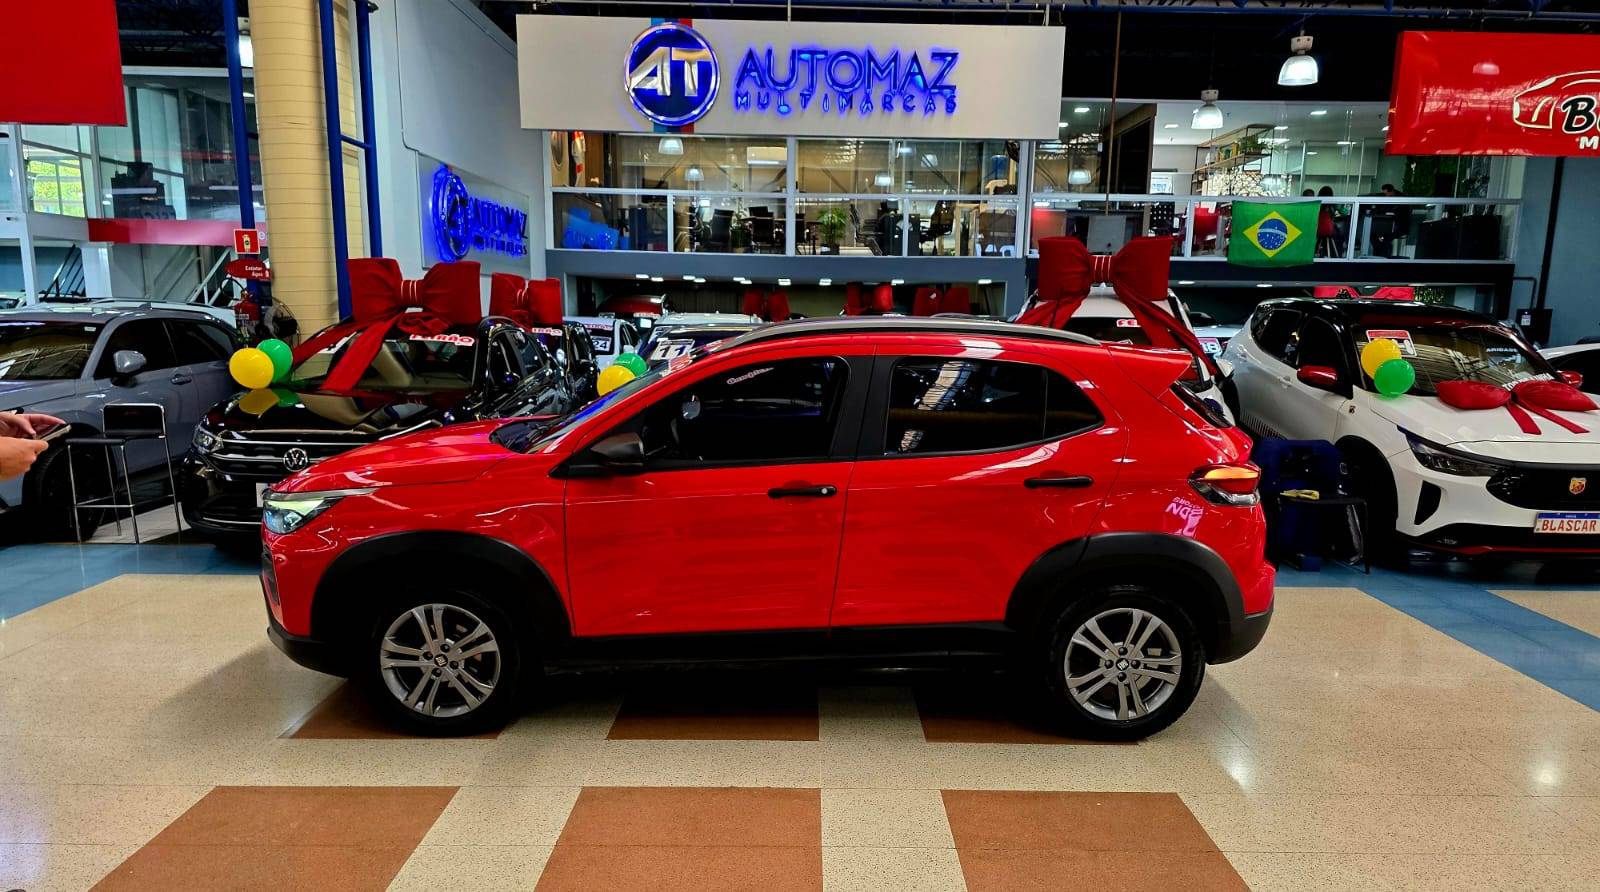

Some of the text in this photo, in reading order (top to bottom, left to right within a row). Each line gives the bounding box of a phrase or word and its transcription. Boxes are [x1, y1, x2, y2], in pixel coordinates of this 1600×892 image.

[735, 48, 960, 92] AUTOMAZ
[736, 90, 958, 114] MULTIMARCAS
[1541, 519, 1597, 531] BLASCAR
